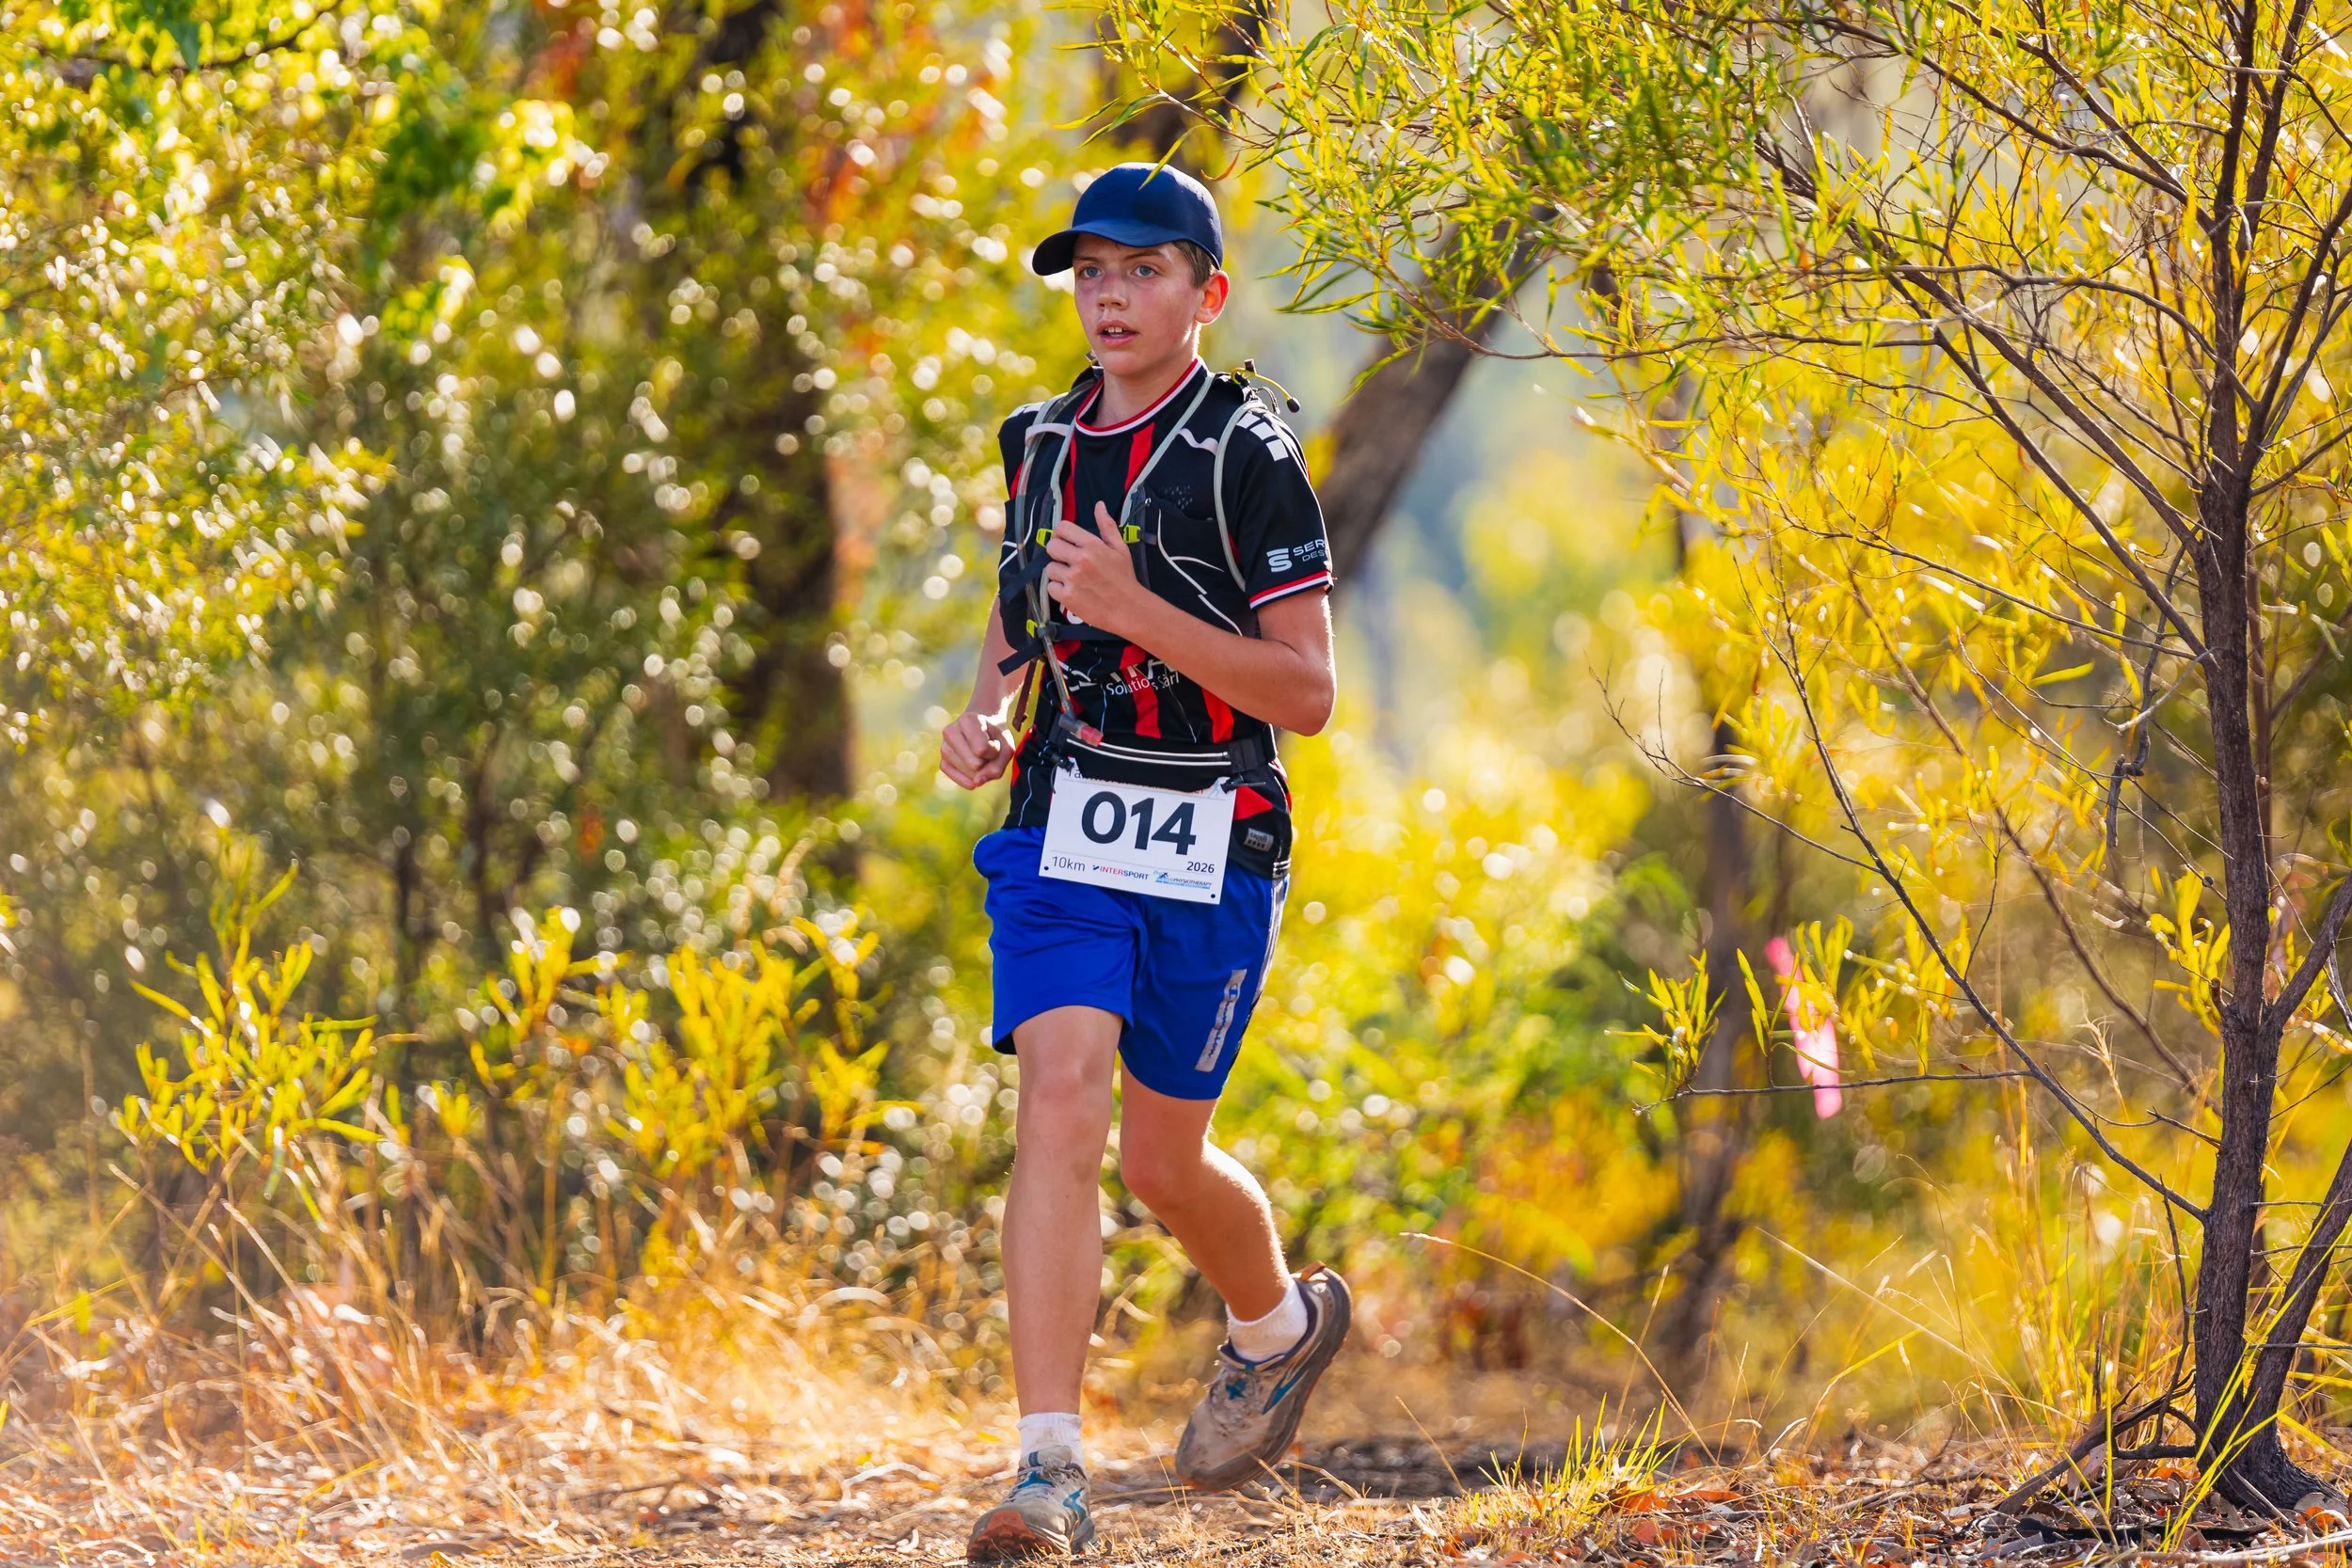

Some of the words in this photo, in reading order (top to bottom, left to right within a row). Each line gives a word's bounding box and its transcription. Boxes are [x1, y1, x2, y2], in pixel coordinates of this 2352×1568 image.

[1081, 791, 1197, 855] 014
[1052, 856, 1086, 872] 10km
[1100, 866, 1150, 880] INTERSPORT
[1186, 861, 1216, 873] 2026
